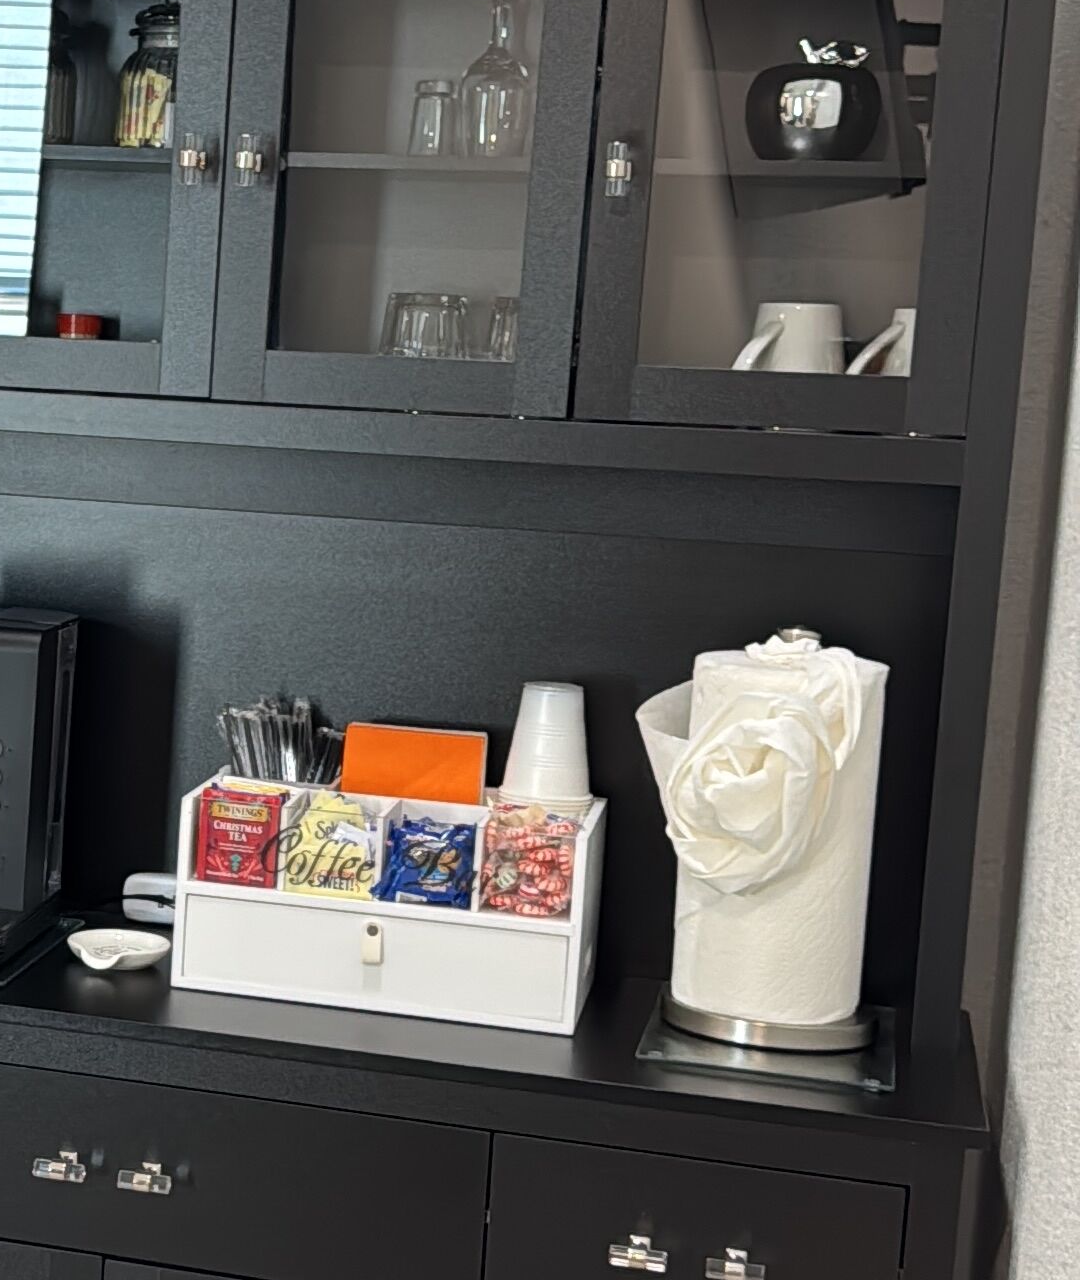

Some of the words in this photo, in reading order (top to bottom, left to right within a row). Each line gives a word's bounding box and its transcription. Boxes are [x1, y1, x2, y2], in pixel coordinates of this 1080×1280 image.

[217, 804, 264, 818] TWININGS
[213, 820, 263, 835] CHRISTMAS
[228, 831, 247, 842] TEA
[261, 823, 376, 888] Coffee
